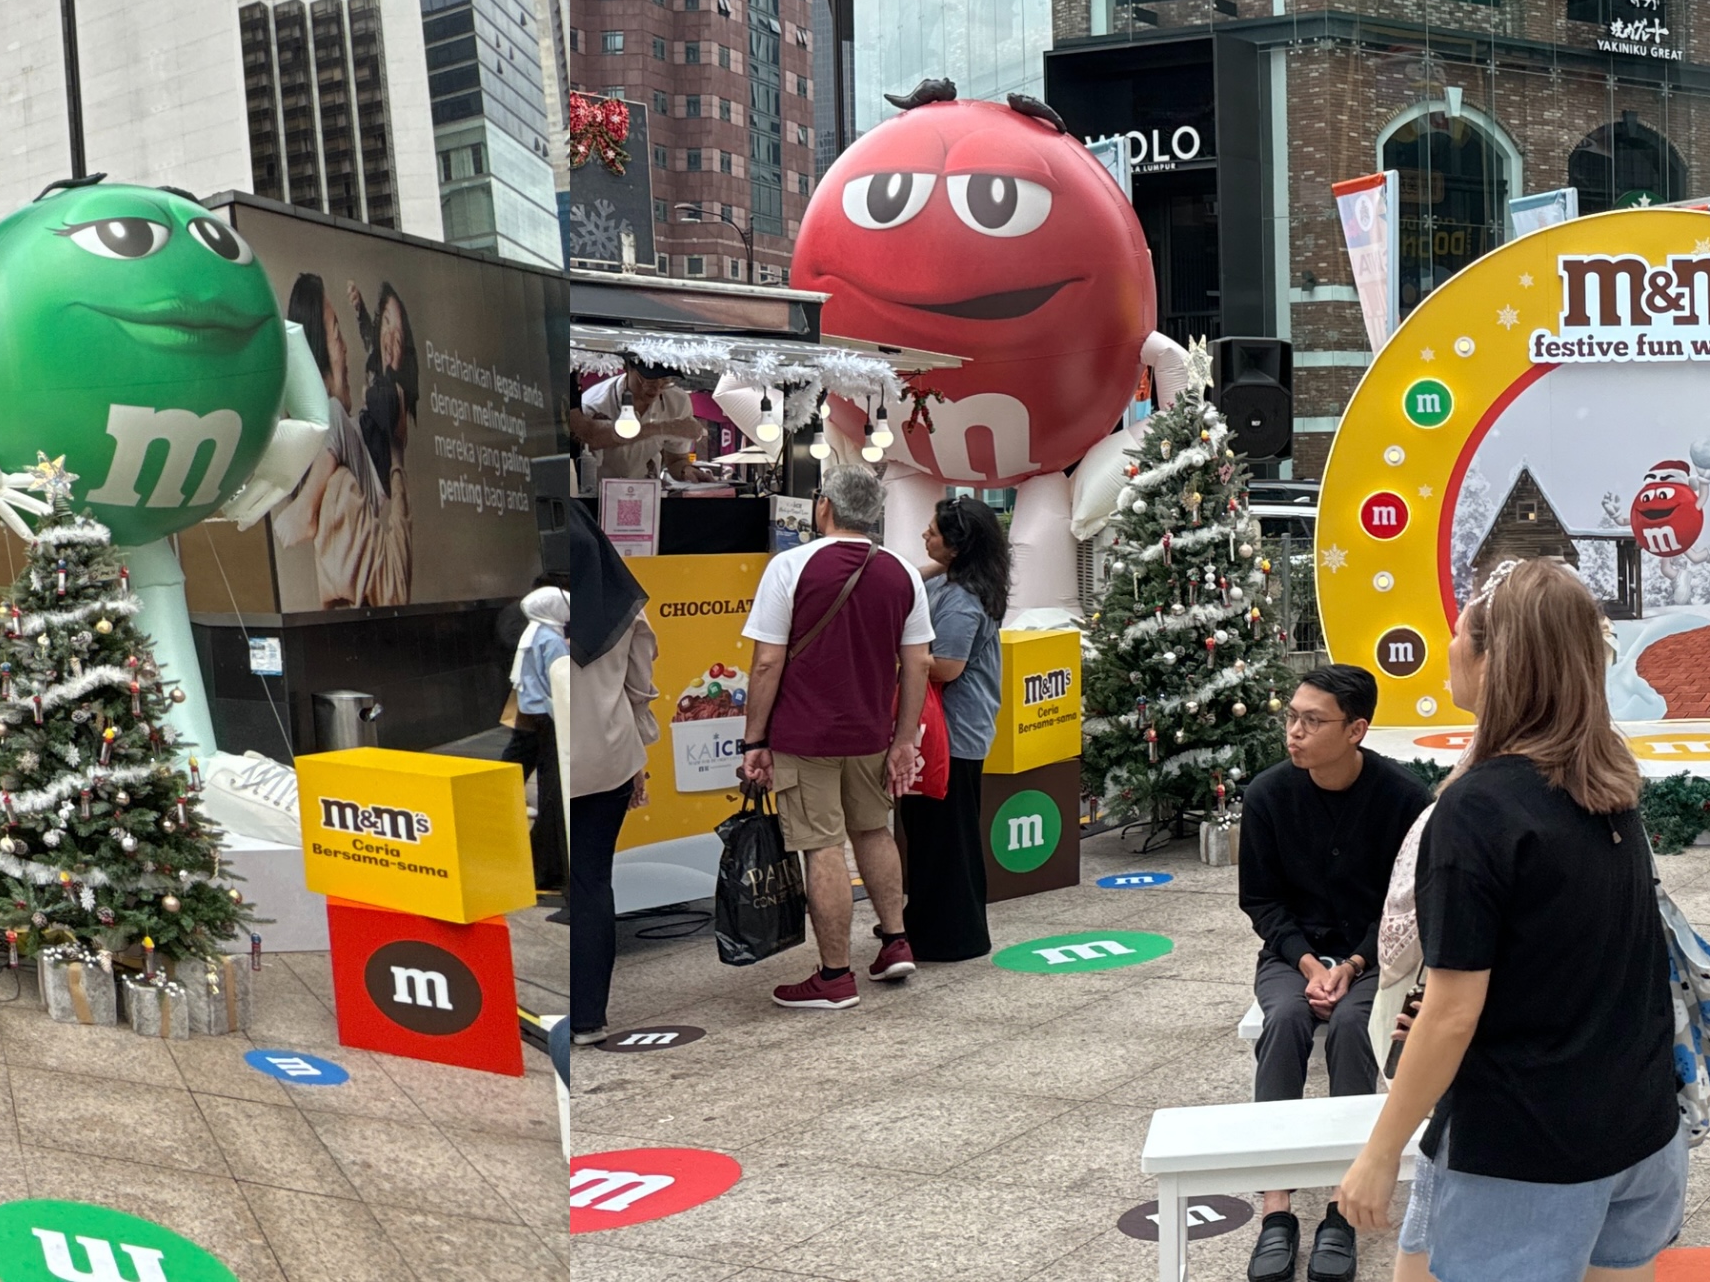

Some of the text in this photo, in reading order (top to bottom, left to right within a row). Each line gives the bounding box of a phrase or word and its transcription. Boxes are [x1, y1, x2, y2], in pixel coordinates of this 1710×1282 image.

[1143, 163, 1176, 173] LUMPUR
[1535, 334, 1629, 359] festive
[1636, 333, 1685, 357] fun
[426, 340, 544, 409] Pertahankan legasi anda
[430, 383, 527, 444] dengan melindungi
[85, 404, 242, 507] m
[434, 430, 531, 483] mereka yang paling
[439, 474, 529, 516] penting bagi anda
[1018, 714, 1078, 734] Bersama-sama
[1037, 705, 1060, 717] Ceria
[311, 842, 448, 879] Bersama-sama
[352, 839, 401, 858] Ceria
[391, 966, 452, 1010] m
